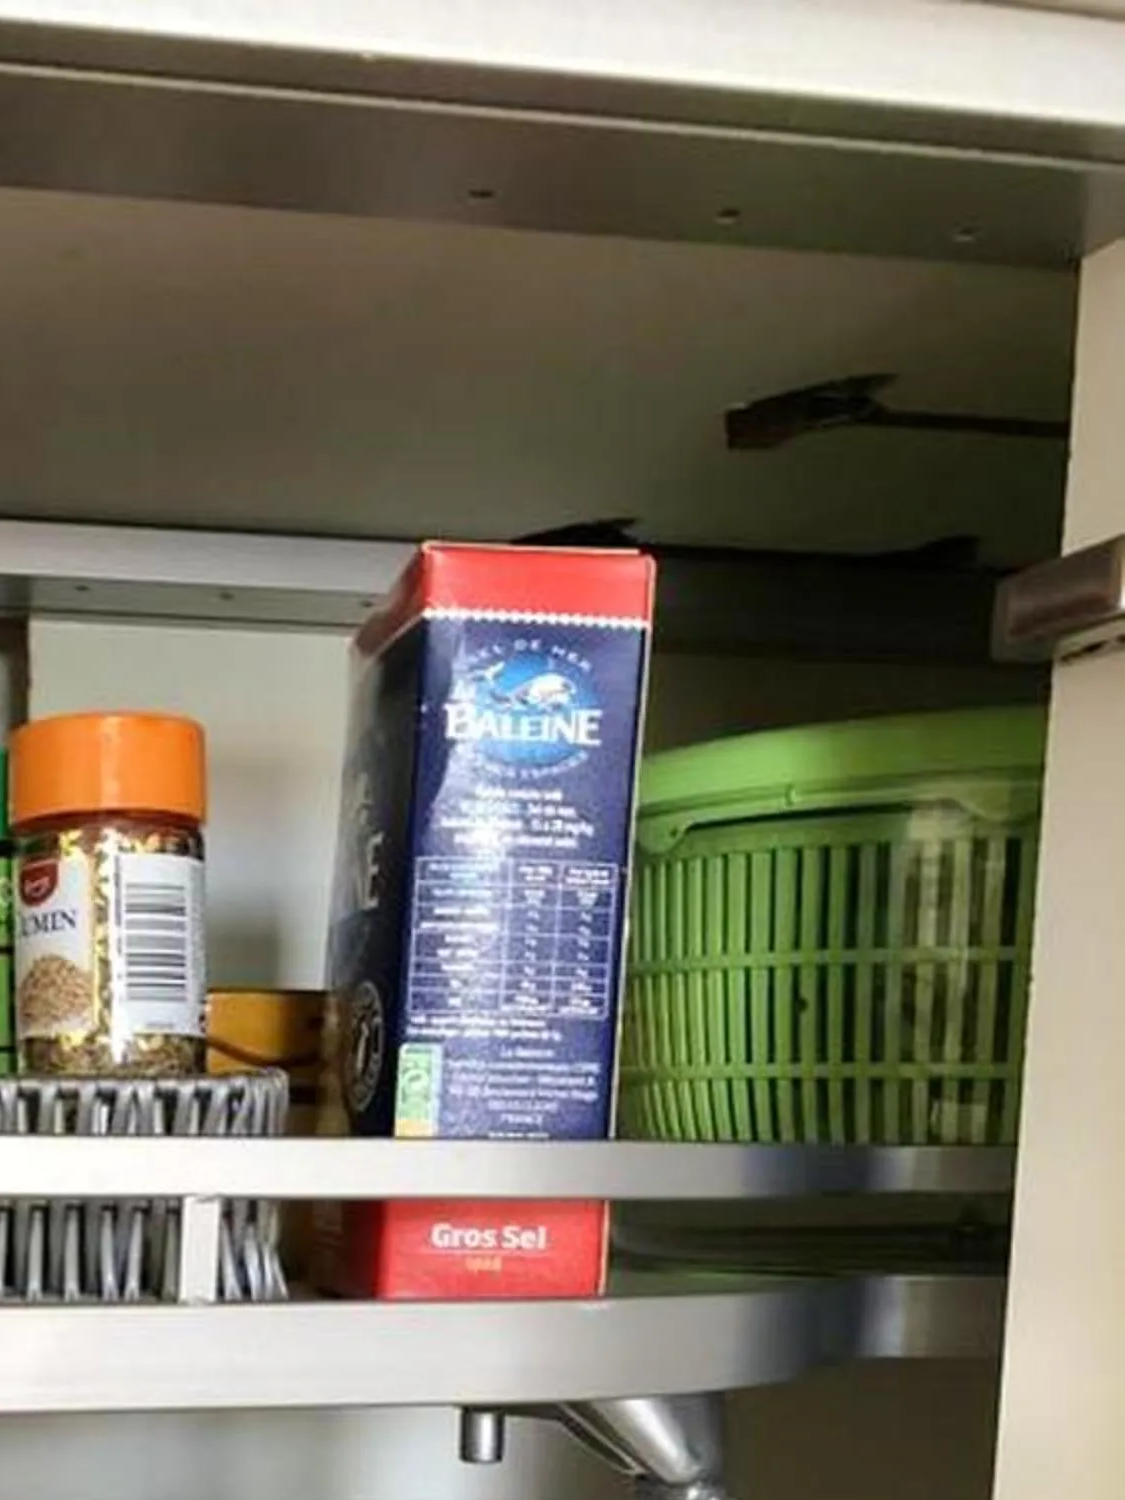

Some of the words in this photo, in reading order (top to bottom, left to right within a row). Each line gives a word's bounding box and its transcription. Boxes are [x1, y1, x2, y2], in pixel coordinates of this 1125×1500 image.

[443, 702, 603, 746] BALEINE
[430, 1222, 498, 1249] Gros
[502, 1224, 548, 1250] Sel
